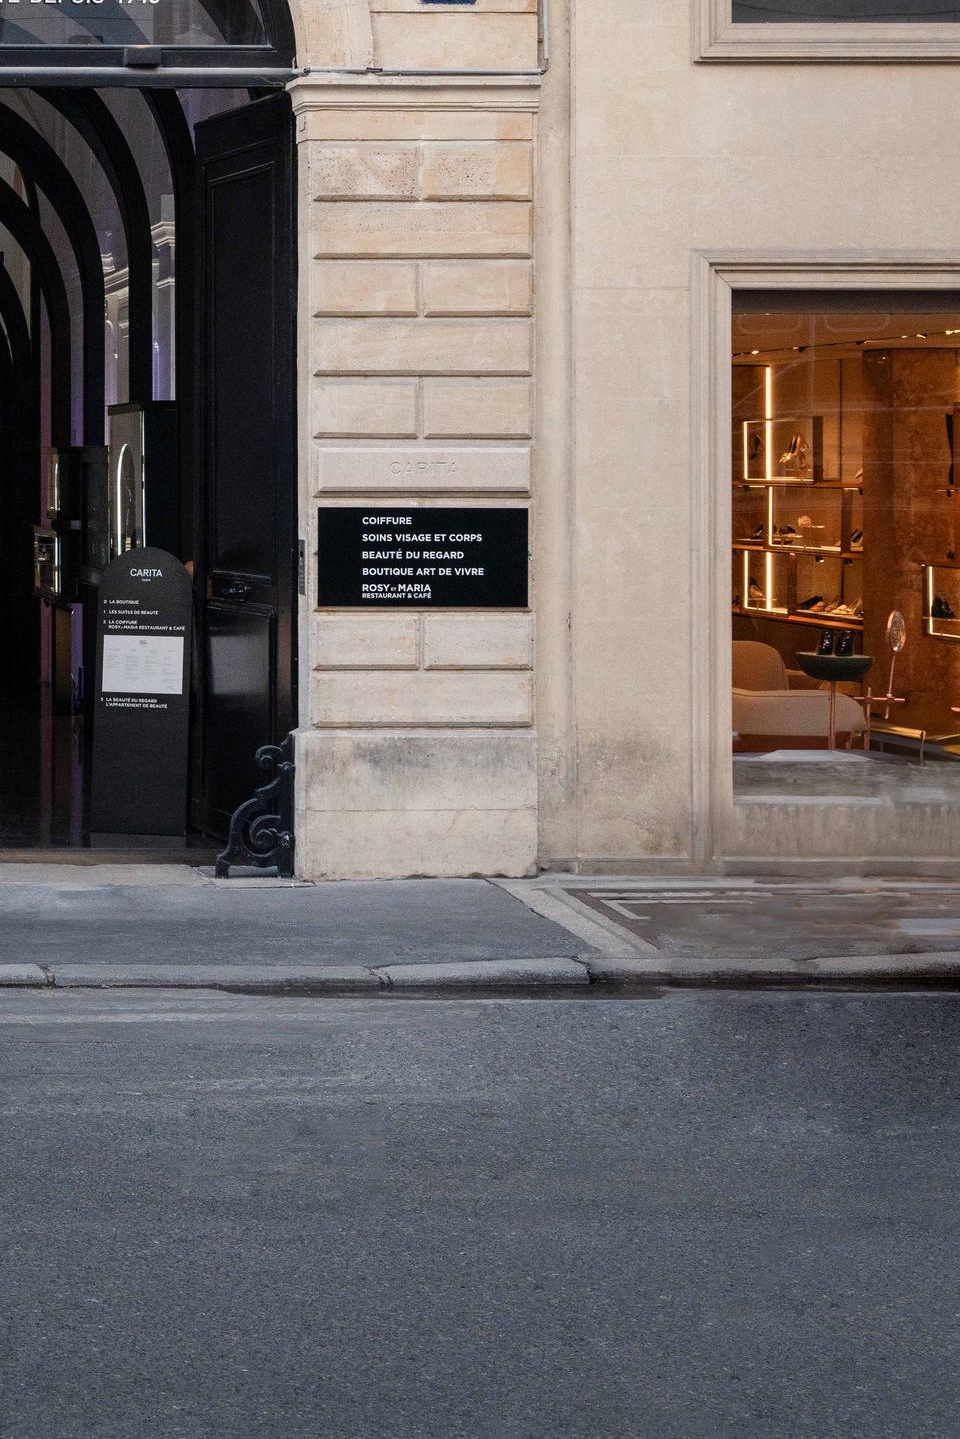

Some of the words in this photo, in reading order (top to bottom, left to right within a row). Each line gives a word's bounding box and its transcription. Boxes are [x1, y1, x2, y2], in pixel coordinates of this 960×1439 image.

[362, 516, 413, 525] COIFFURE
[361, 533, 393, 542] SOINS
[395, 533, 432, 542] VISAGE
[434, 533, 446, 542] ET
[448, 533, 483, 542] CORPS
[361, 548, 403, 560] BEAUTÉ
[405, 550, 420, 560] DU
[422, 550, 465, 560] REGARD
[129, 568, 163, 578] CARITA
[362, 567, 414, 577] BOUTIQUE
[416, 567, 436, 576] ART
[438, 567, 452, 576] DE
[454, 567, 485, 576] VIVRE
[361, 583, 390, 592] ROSY
[397, 583, 432, 592] MARIA
